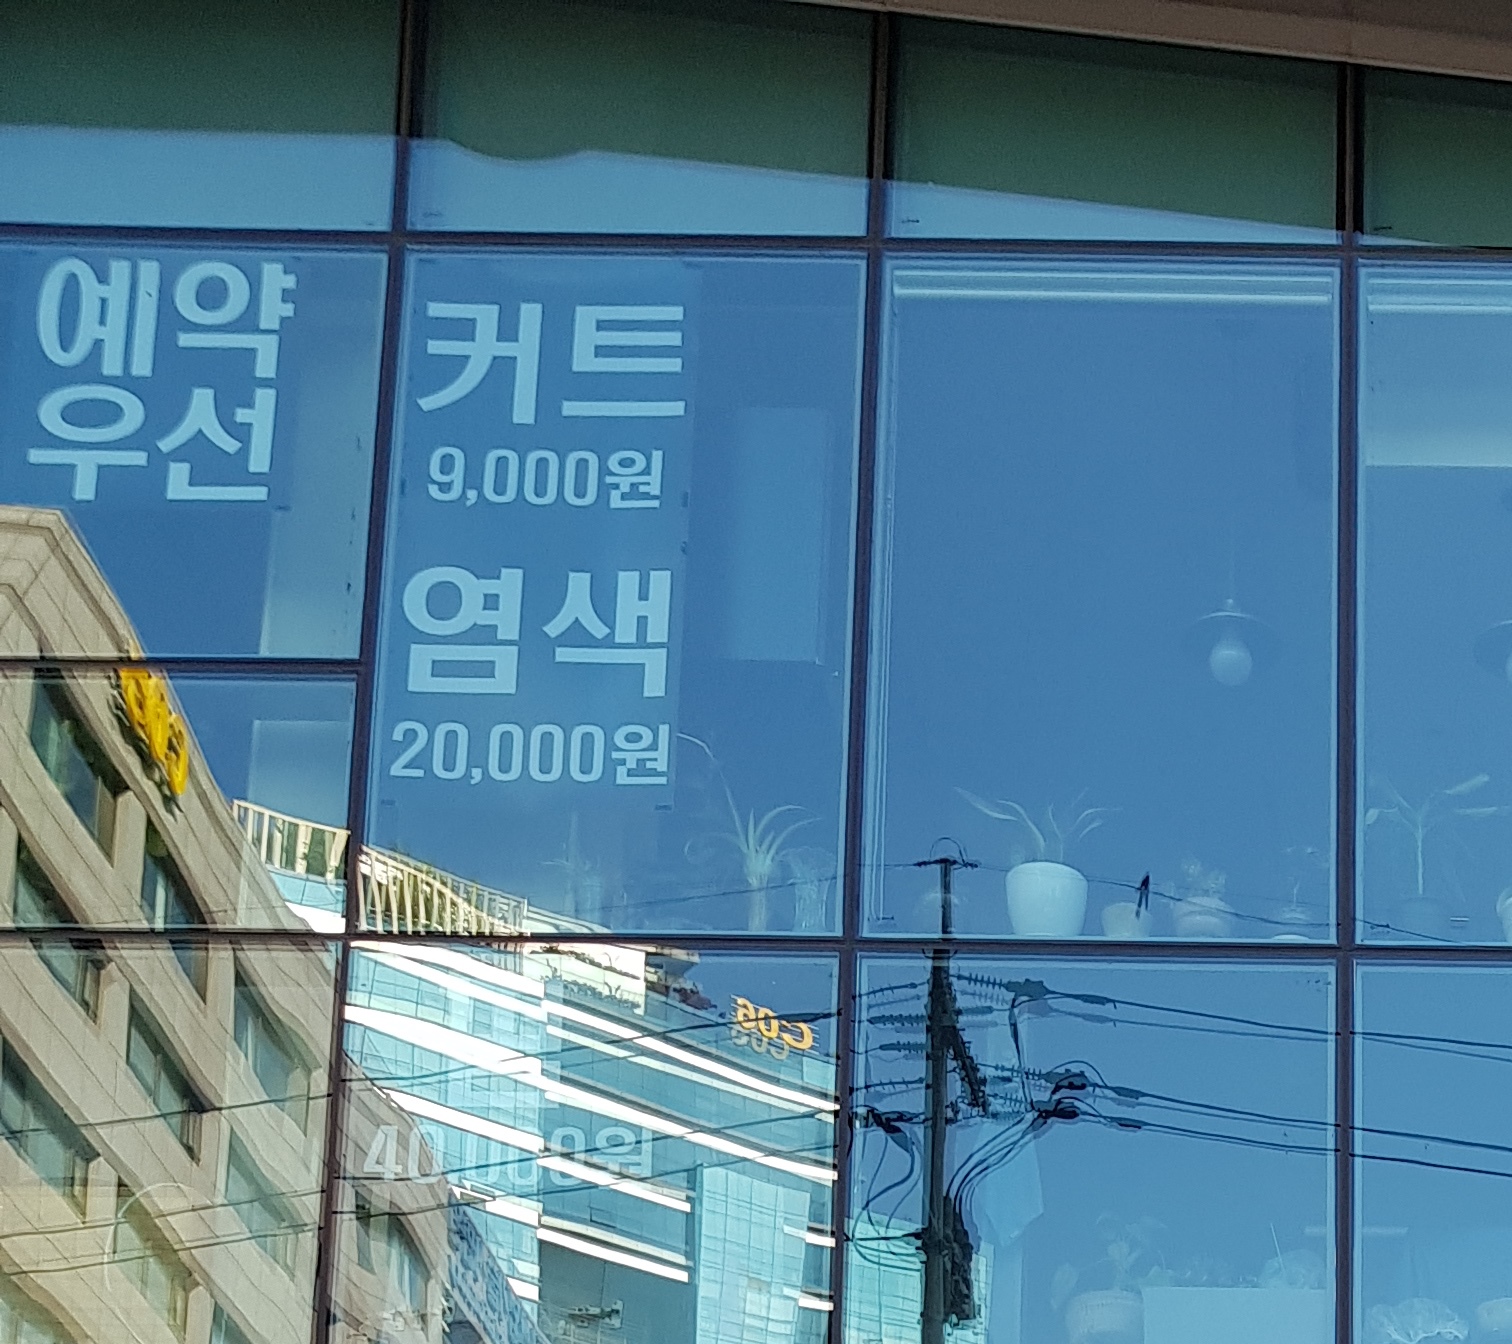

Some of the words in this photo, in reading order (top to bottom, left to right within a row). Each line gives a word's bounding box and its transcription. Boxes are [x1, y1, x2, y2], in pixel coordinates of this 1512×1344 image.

[37, 257, 296, 378] 예약
[416, 302, 686, 424] 커트
[27, 384, 277, 501] 우선
[427, 446, 663, 509] 9,000원
[402, 565, 671, 698] 염색
[389, 721, 670, 785] 20,000원
